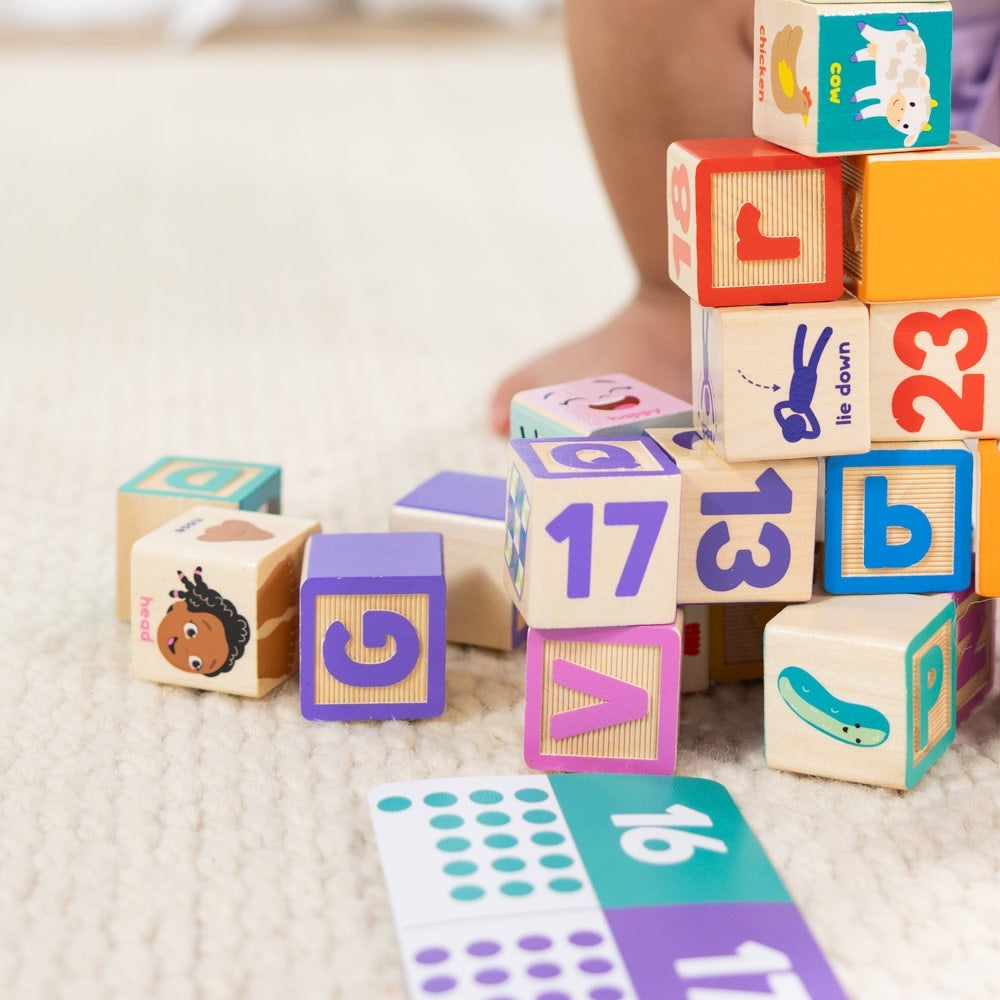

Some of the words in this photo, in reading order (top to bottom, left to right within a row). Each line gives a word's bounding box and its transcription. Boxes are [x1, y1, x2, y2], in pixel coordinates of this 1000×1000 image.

[758, 24, 768, 102] chicken
[829, 62, 842, 104] cow
[671, 163, 692, 279] 18
[834, 341, 851, 396] down
[892, 308, 988, 432] 23
[607, 407, 661, 422] happy
[835, 402, 852, 426] lie
[165, 466, 243, 492] D
[551, 443, 641, 469] Q
[545, 501, 668, 598] 17
[696, 467, 792, 592] 13
[140, 596, 154, 643] head
[322, 609, 420, 687] G
[551, 658, 648, 740] V
[919, 644, 944, 750] P
[610, 804, 728, 865] 16
